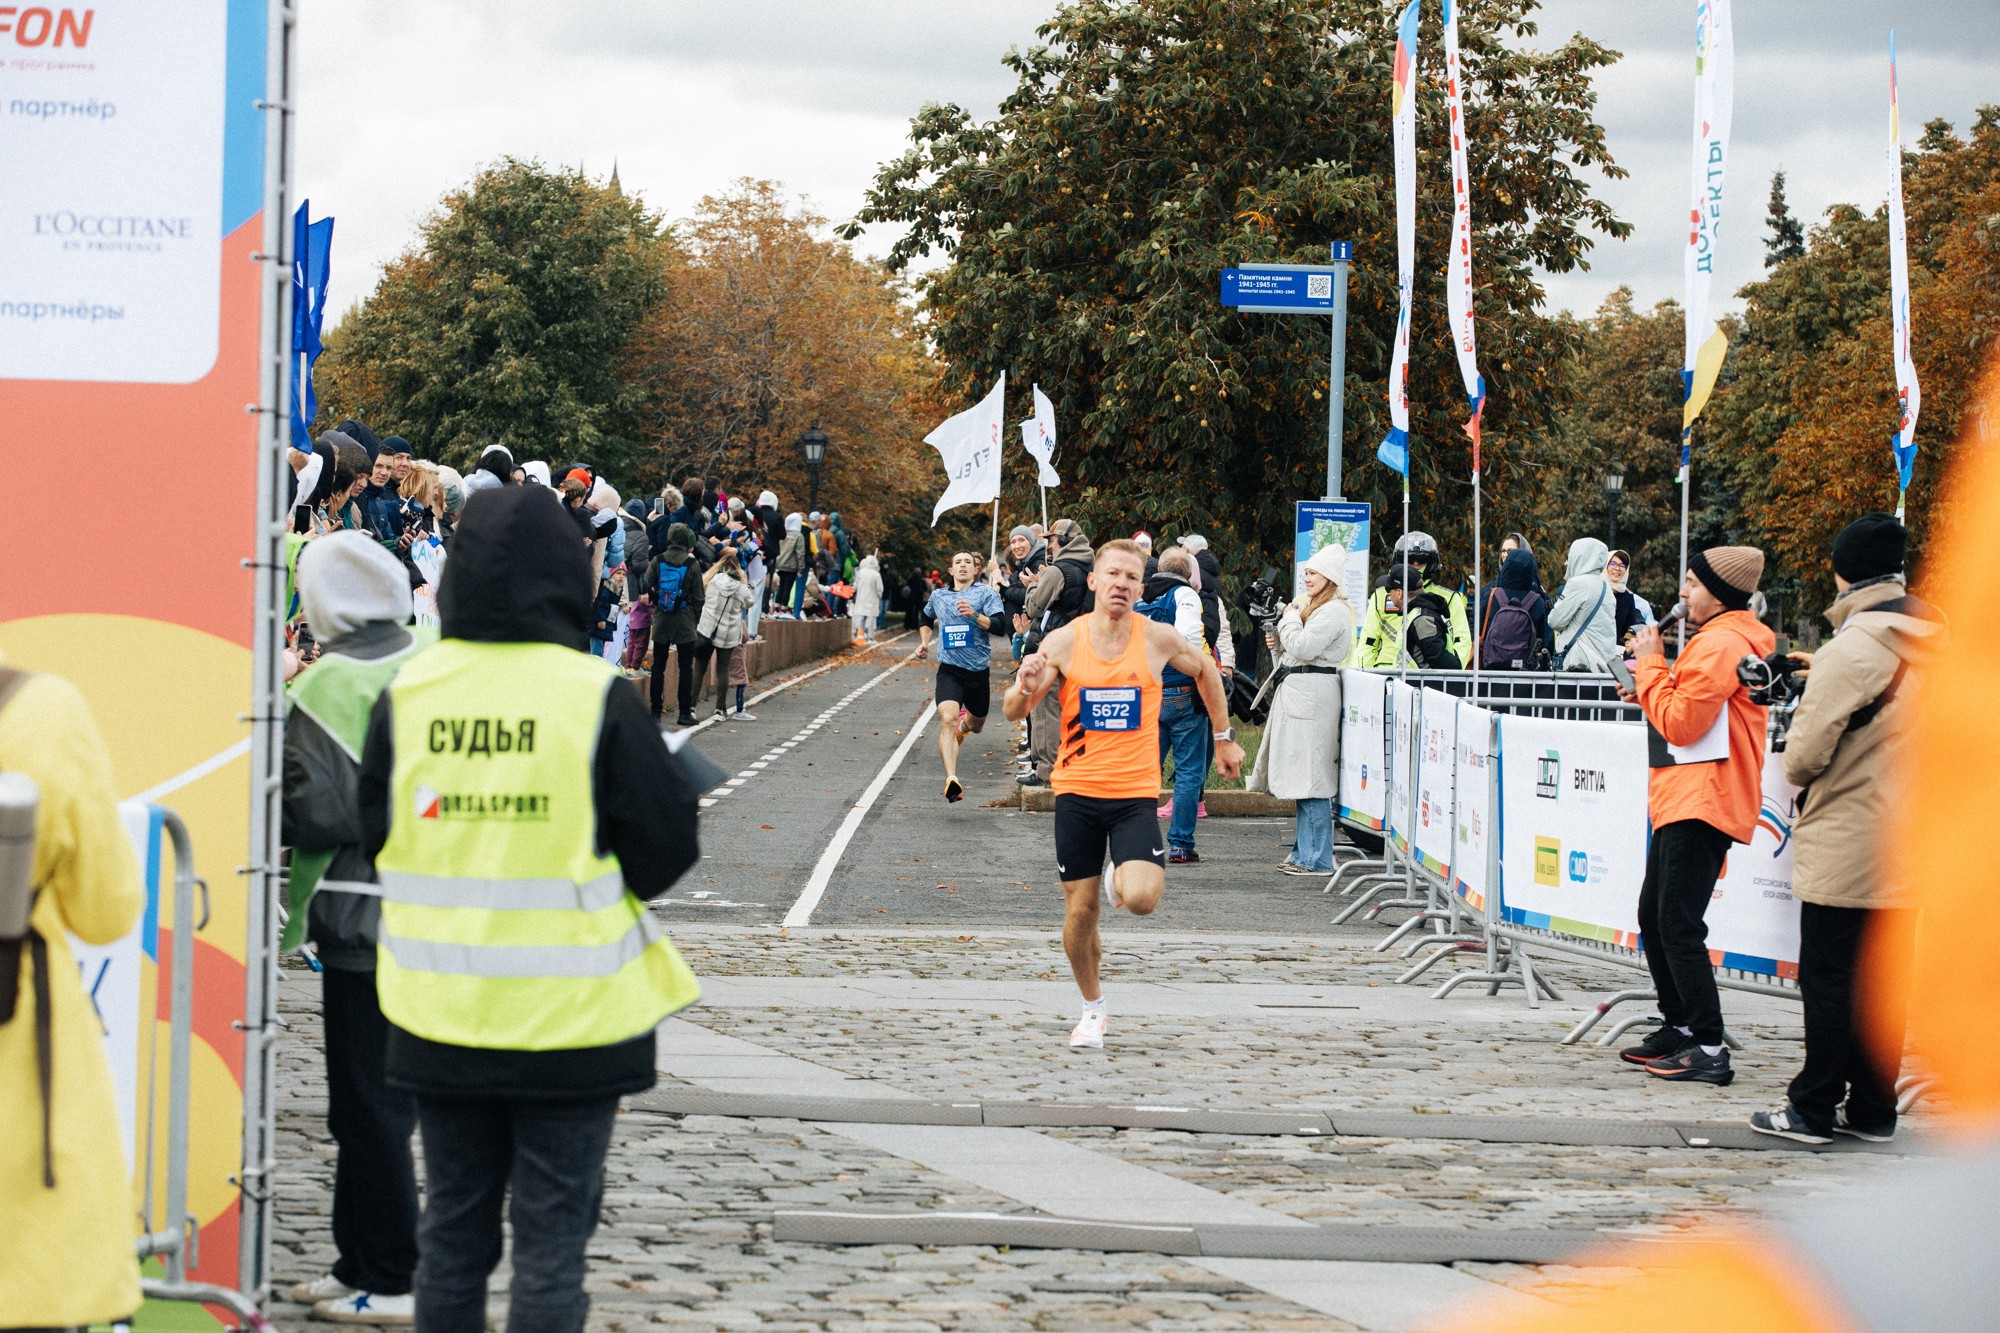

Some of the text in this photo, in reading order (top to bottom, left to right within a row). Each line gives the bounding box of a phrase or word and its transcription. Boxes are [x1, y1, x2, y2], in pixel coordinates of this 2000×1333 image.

[10, 97, 116, 120] партнёр
[1, 299, 124, 322] партнёры
[948, 632, 966, 641] 5127
[1092, 703, 1130, 717] 5672
[430, 719, 535, 759] СУДЬЯ
[1574, 768, 1605, 793] BRITVA
[1570, 857, 1587, 878] CMD
